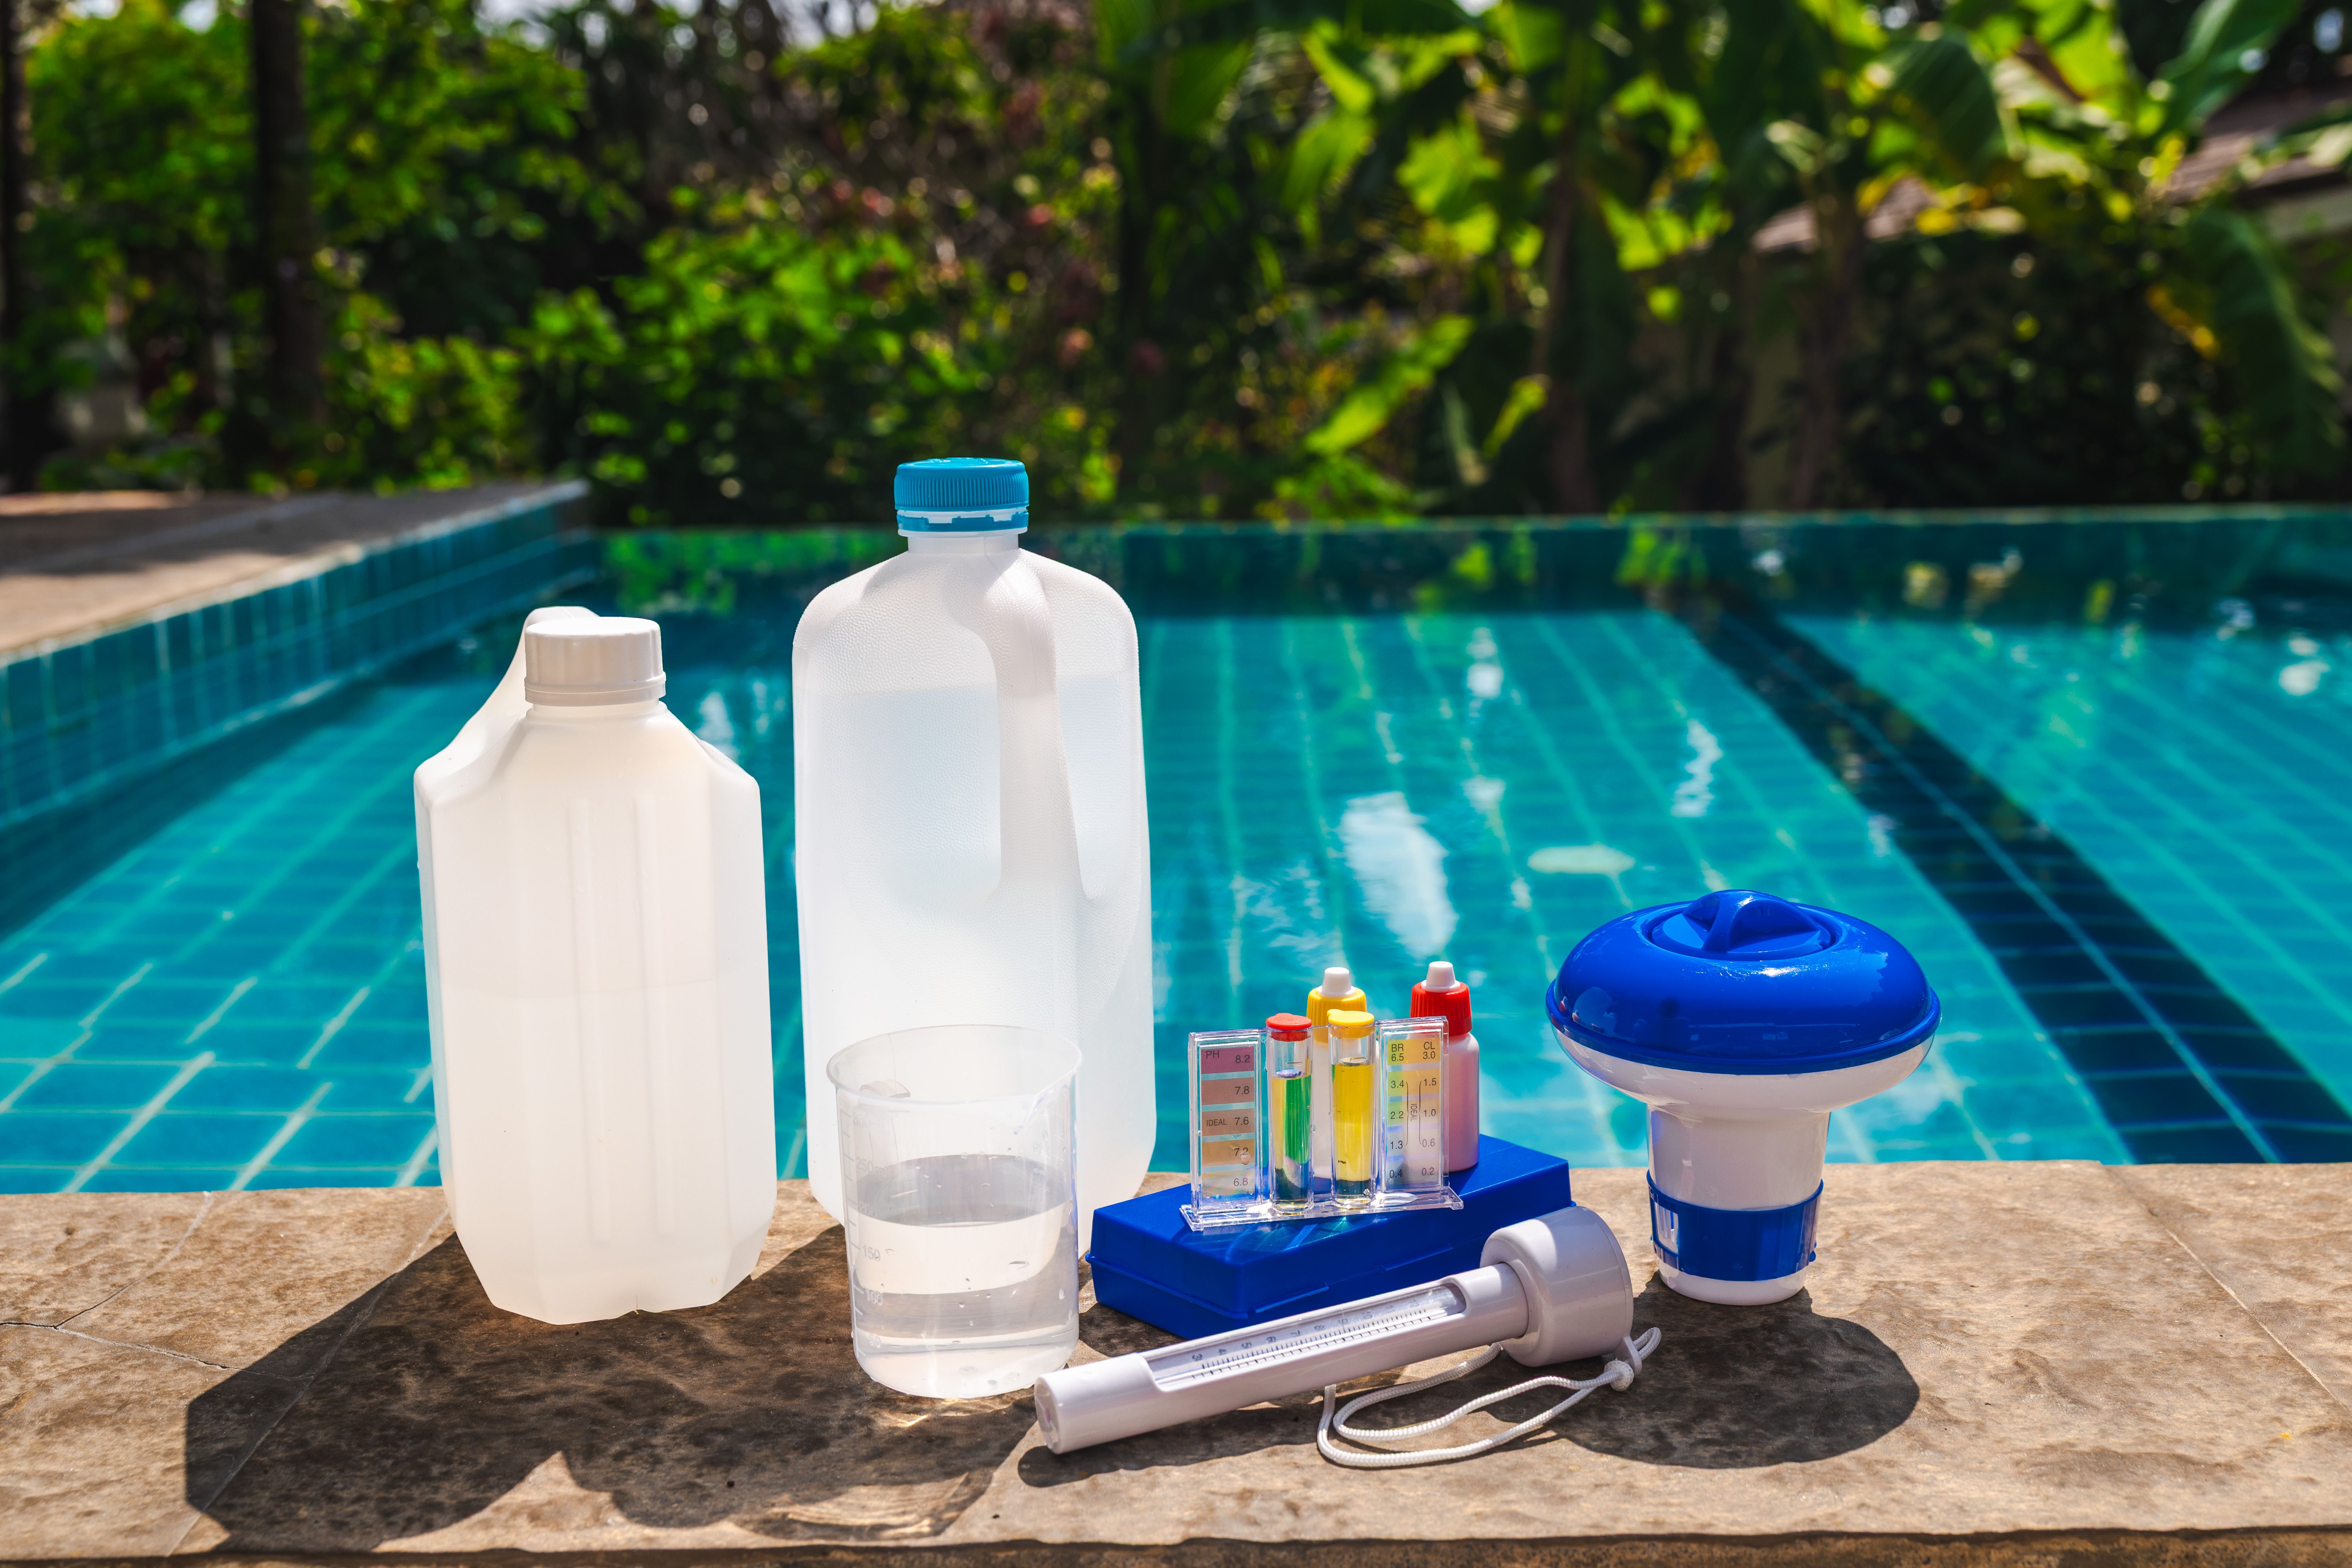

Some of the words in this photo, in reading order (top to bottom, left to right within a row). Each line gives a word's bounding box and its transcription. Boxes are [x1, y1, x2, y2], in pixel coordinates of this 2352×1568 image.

[1391, 1044, 1404, 1052] BR
[1424, 1041, 1436, 1050] CL
[1206, 1050, 1220, 1059] PH
[1235, 1054, 1250, 1064] 8.2
[1391, 1053, 1404, 1062] 6.5
[1423, 1051, 1436, 1060] 3.0
[1391, 1080, 1404, 1089] 3.4
[1424, 1078, 1437, 1087] 1.5
[1235, 1086, 1250, 1095] 7.8
[1390, 1111, 1404, 1120] 2.2
[1424, 1109, 1436, 1118] 1.0
[1206, 1118, 1227, 1127] IDEAL
[1234, 1116, 1249, 1126] 7.6
[1390, 1141, 1403, 1150] 1.3
[1422, 1139, 1435, 1148] 0.6
[1234, 1147, 1249, 1157] 7.2
[856, 1156, 873, 1173] 250
[1390, 1169, 1403, 1178] 0.4
[1422, 1167, 1435, 1176] 0.2
[1234, 1177, 1249, 1187] 6.8
[862, 1245, 881, 1262] 150
[866, 1288, 884, 1306] 100
